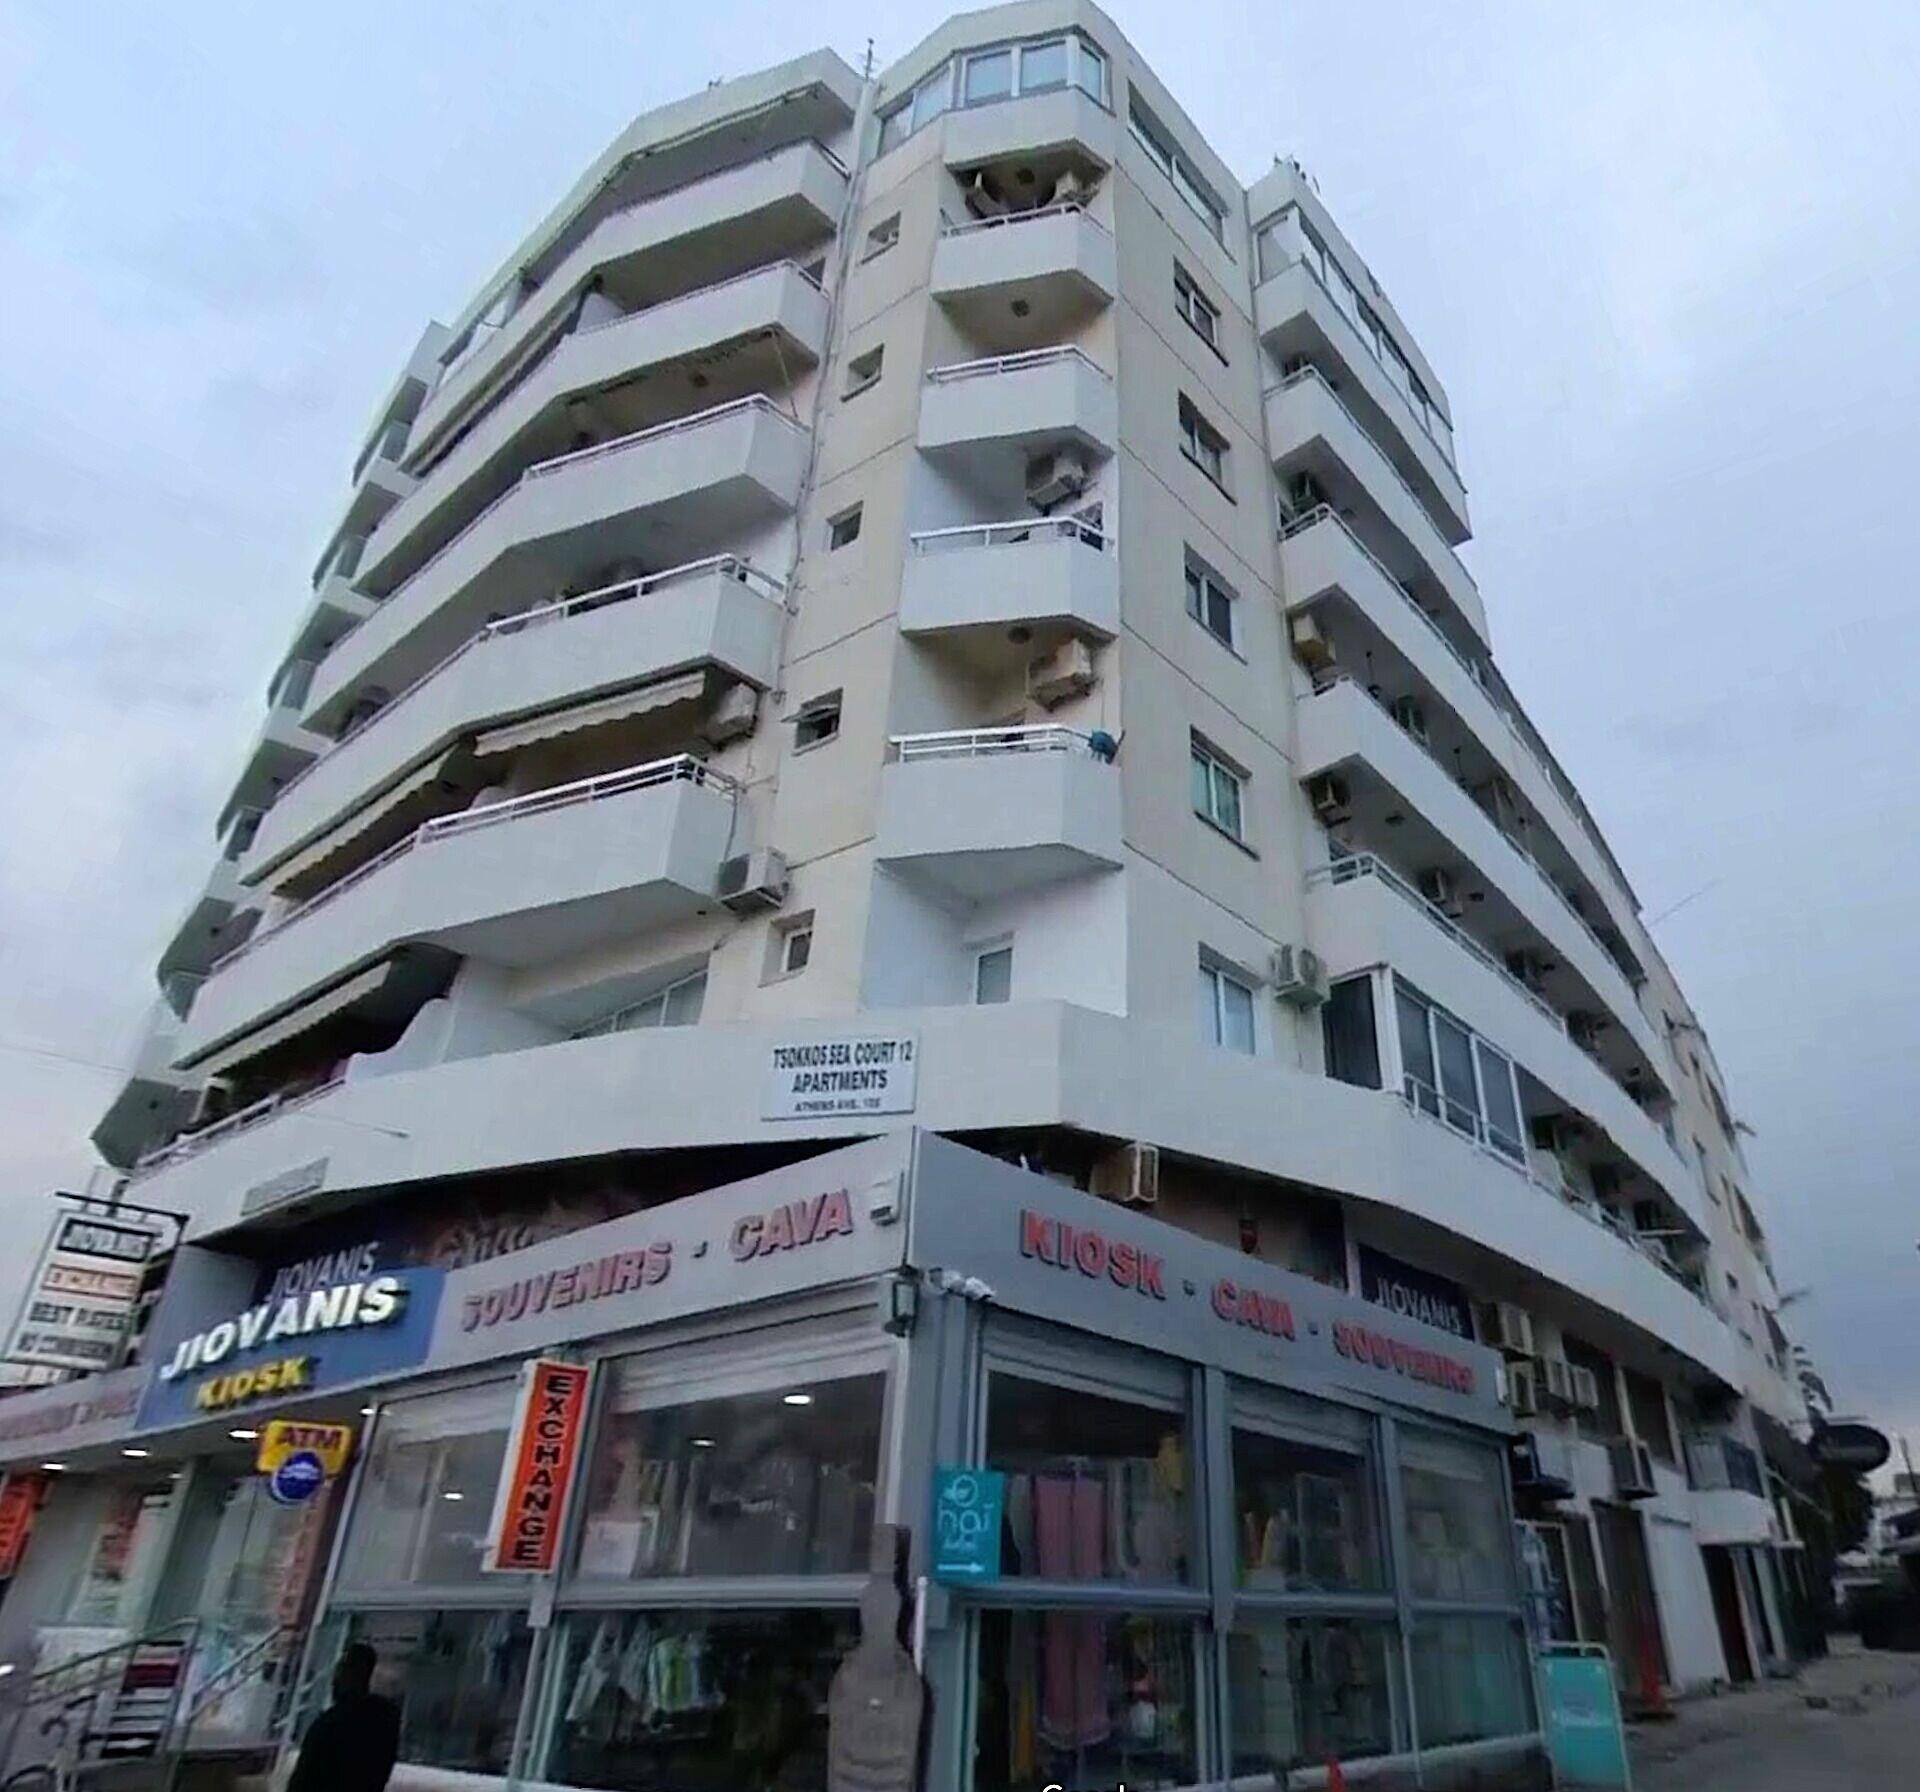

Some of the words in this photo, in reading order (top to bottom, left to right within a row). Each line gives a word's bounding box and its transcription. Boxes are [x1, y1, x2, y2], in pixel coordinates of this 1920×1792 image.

[773, 1046, 828, 1069] TSOKKOS
[829, 1044, 852, 1066] SEA
[854, 1041, 897, 1065] COURT
[899, 1040, 912, 1061] 12
[791, 1069, 888, 1093] APARTMENTS
[265, 1241, 379, 1303] JIOVANIS
[460, 1240, 674, 1333] SOUVENIRS
[728, 1189, 854, 1262] CAVA
[159, 1276, 399, 1380] JIOVANIS
[1020, 1208, 1168, 1300] KIOSK
[1211, 1279, 1296, 1342] CAVA
[1331, 1317, 1477, 1394] SOUVENIRS
[196, 1355, 312, 1408] KIOSK
[278, 1427, 341, 1451] ATM
[514, 1374, 573, 1562] EXCHANGE
